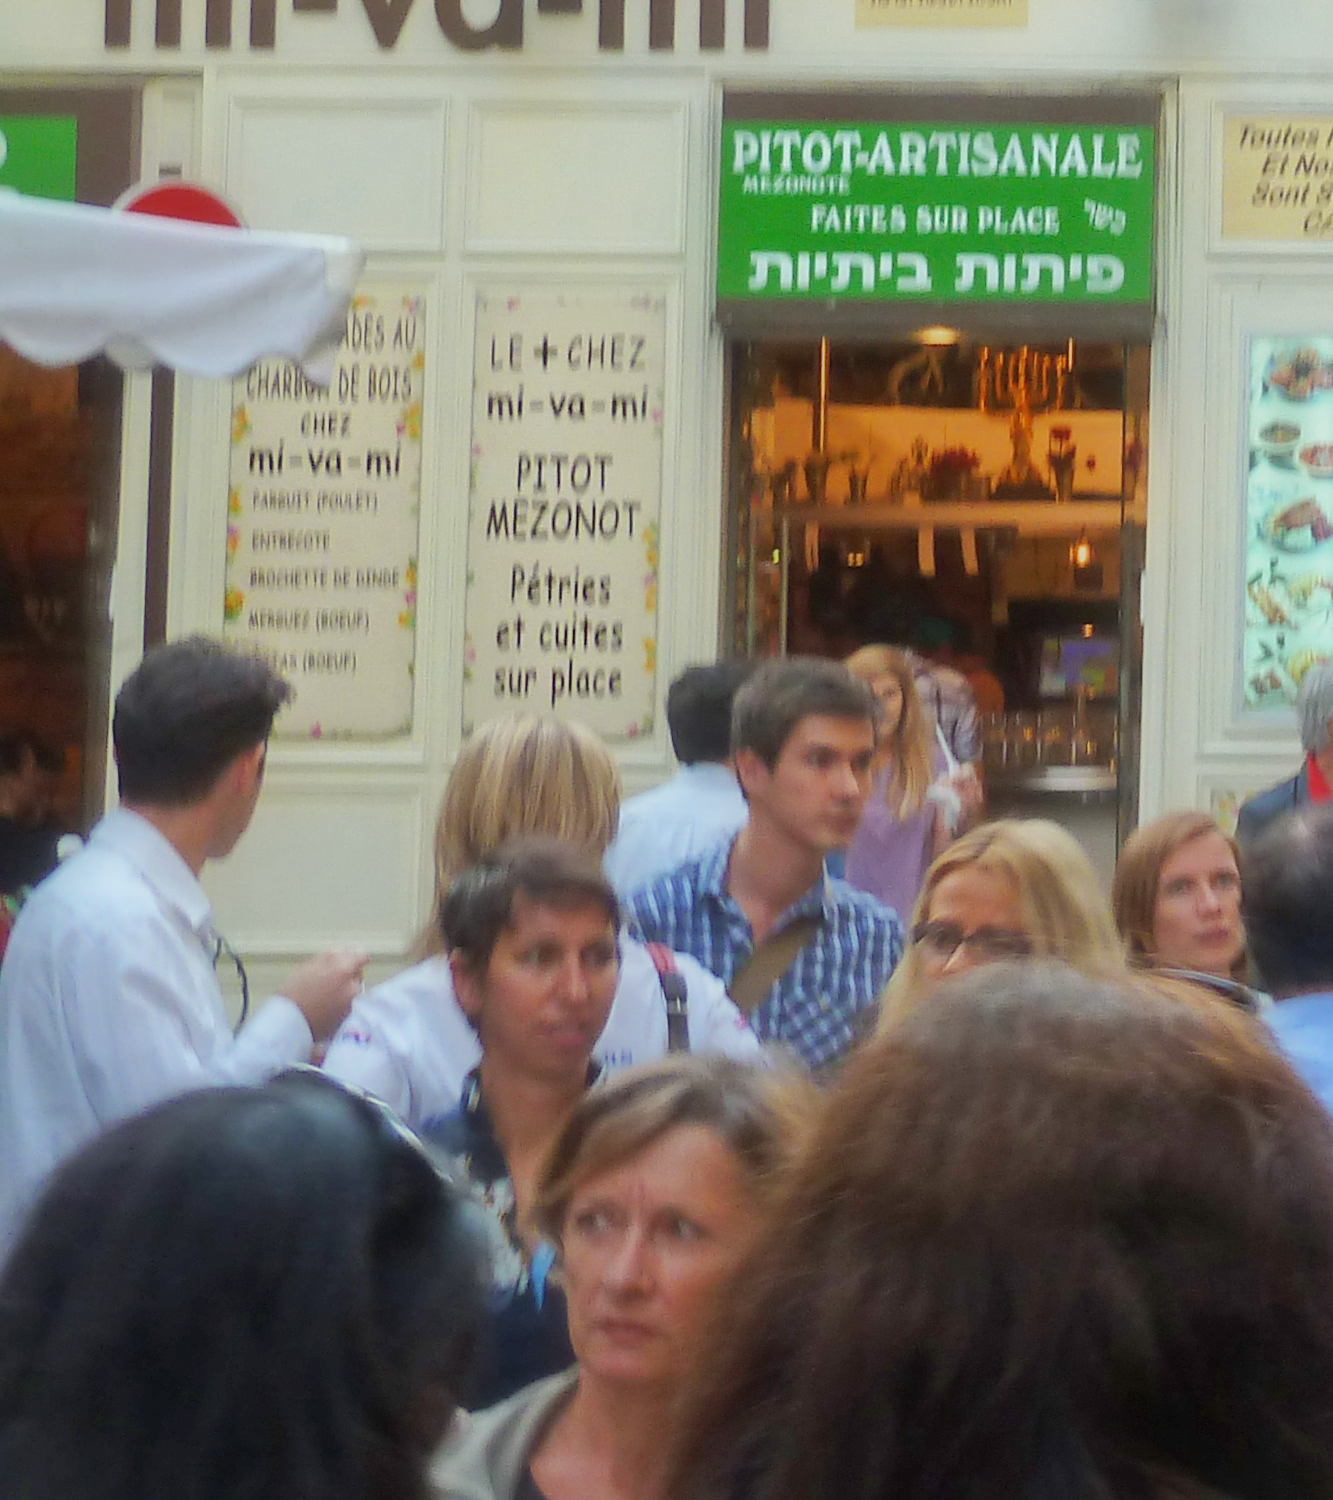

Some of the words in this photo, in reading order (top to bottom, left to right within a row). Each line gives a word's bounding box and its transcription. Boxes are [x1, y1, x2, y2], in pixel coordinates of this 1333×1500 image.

[733, 130, 1142, 178] PITOT-ARTISANALE
[1239, 122, 1319, 150] Toutes
[1262, 153, 1290, 177] Et
[1252, 179, 1311, 208] Sont
[811, 203, 907, 235] FAITES
[916, 204, 968, 235] SUR
[978, 204, 1061, 236] PLACE
[748, 250, 933, 294] ביתיות
[954, 251, 1126, 294] פיתות
[393, 315, 417, 350] AU
[491, 332, 523, 372] LE
[567, 332, 647, 372] CHEZ
[338, 363, 360, 402] DE
[368, 363, 412, 402] BOIS
[487, 382, 649, 422] mi-va-mi
[301, 411, 351, 437] CHEZ
[249, 439, 401, 477] mi-va-mi
[516, 451, 614, 493] PITOT
[486, 498, 642, 542] MEZONOT
[250, 567, 328, 589] BROCHETTE
[333, 567, 351, 589] DE
[356, 567, 400, 589] DINDE
[511, 560, 611, 605] Pétries
[315, 608, 370, 634] (BOEUF)
[496, 613, 525, 652] et
[539, 610, 623, 652] cuites
[494, 666, 537, 699] sur
[551, 655, 623, 710] place
